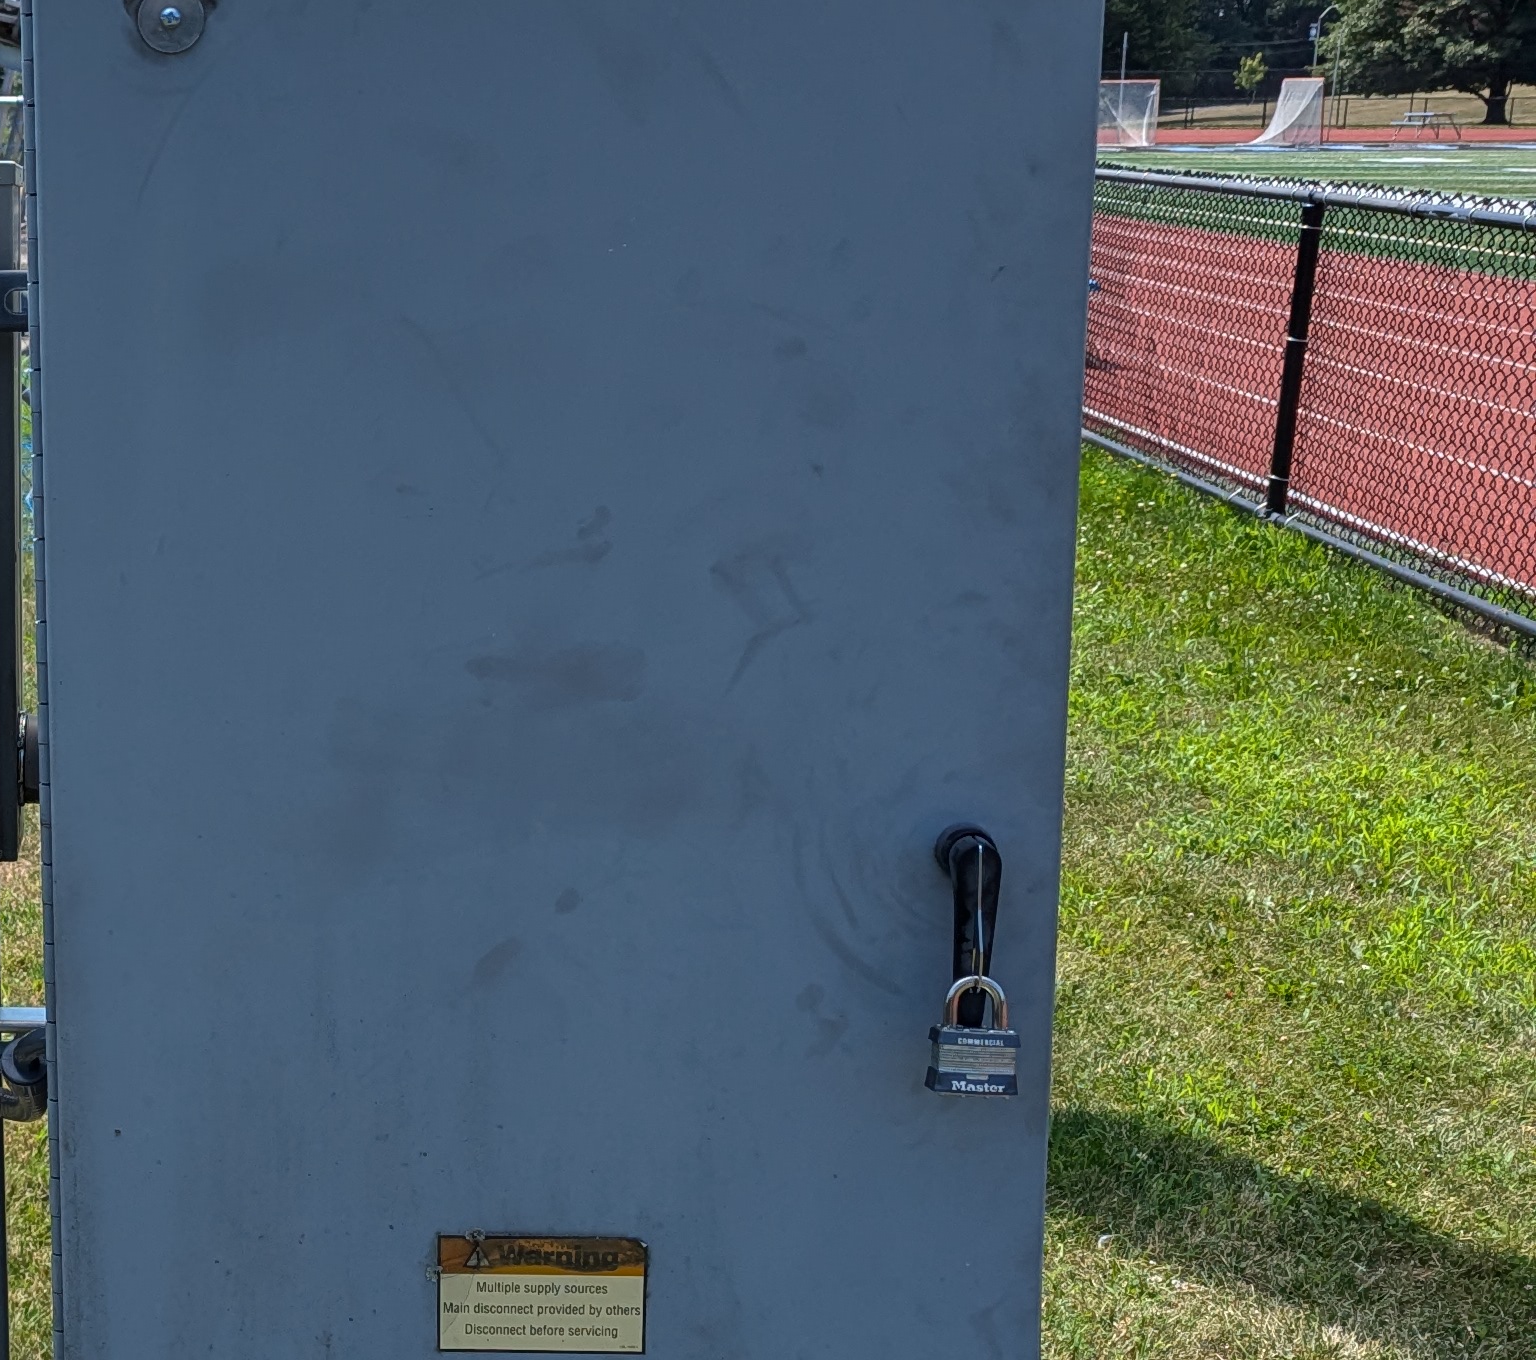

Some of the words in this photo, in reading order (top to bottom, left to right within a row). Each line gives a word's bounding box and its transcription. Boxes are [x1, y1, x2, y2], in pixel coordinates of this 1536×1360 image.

[951, 1080, 1006, 1093] Master
[498, 1243, 619, 1272] Warning
[476, 1281, 521, 1295] Multiple
[523, 1282, 561, 1296] supply
[564, 1284, 608, 1295] sources
[443, 1301, 470, 1314] Main
[473, 1302, 534, 1315] disconnect
[537, 1303, 585, 1317] provided
[589, 1304, 603, 1318] by
[606, 1304, 641, 1316] others
[464, 1323, 527, 1336] Disconnect
[529, 1324, 565, 1337] before
[568, 1325, 618, 1339] servicing
